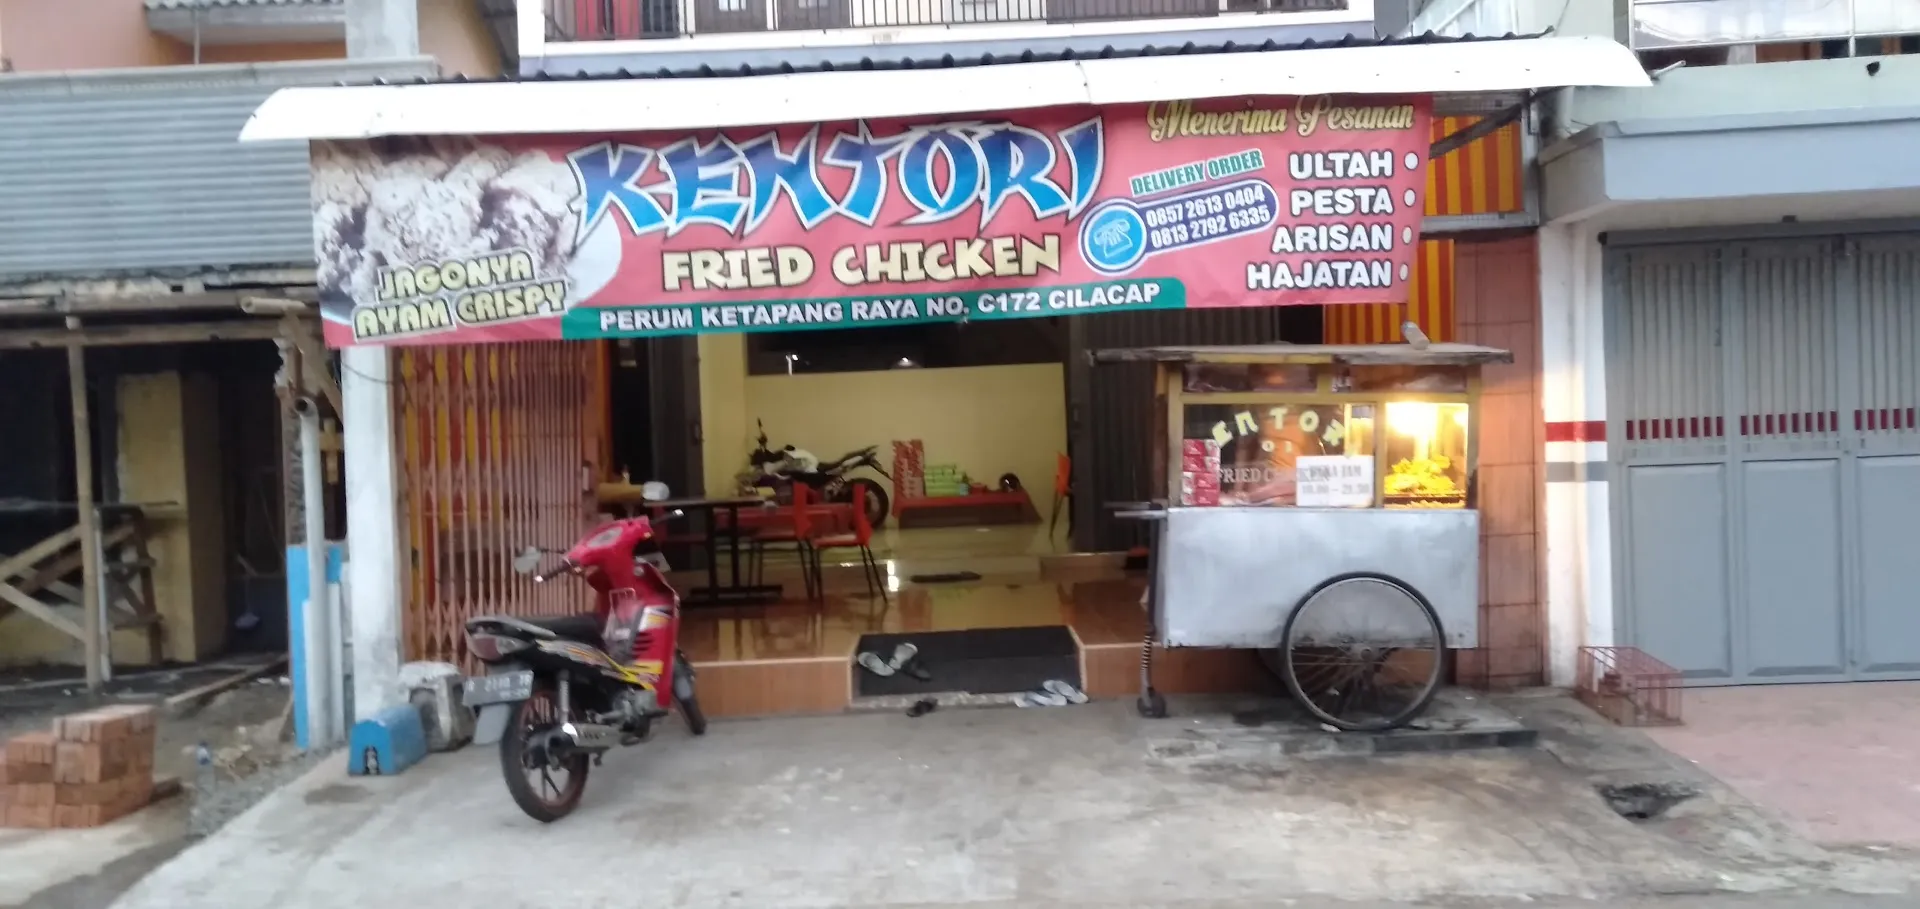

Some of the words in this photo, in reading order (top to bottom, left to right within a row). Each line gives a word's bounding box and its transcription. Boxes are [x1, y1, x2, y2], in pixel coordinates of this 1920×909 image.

[1147, 98, 1288, 142] Menerima
[1295, 95, 1415, 136] Pesanan
[566, 116, 1104, 246] KENTORI
[1130, 162, 1205, 195] DELIVERY
[1208, 150, 1264, 178] ORDER
[1289, 150, 1393, 179] ULTAH
[1146, 203, 1183, 227] 0857
[1186, 195, 1223, 218] 2613
[1225, 185, 1265, 208] 0404
[1291, 187, 1394, 216] PESTA
[1151, 224, 1189, 248] 0813
[1190, 214, 1228, 239] 2792
[1229, 205, 1271, 229] 6335
[1271, 224, 1393, 253] ARISAN
[378, 250, 533, 299] JAGONYA
[662, 245, 815, 291] FRIED
[832, 234, 1060, 284] CHICKEN
[1247, 260, 1392, 289] HAJATAN
[356, 298, 451, 338] AYAM
[456, 279, 565, 323] CRISPY
[600, 308, 692, 331] PERUM
[701, 302, 842, 327] KETAPANG
[851, 299, 918, 321] RAYA
[926, 296, 969, 317] NO.
[977, 292, 1041, 313] C172
[1048, 283, 1160, 309] CILACAP
